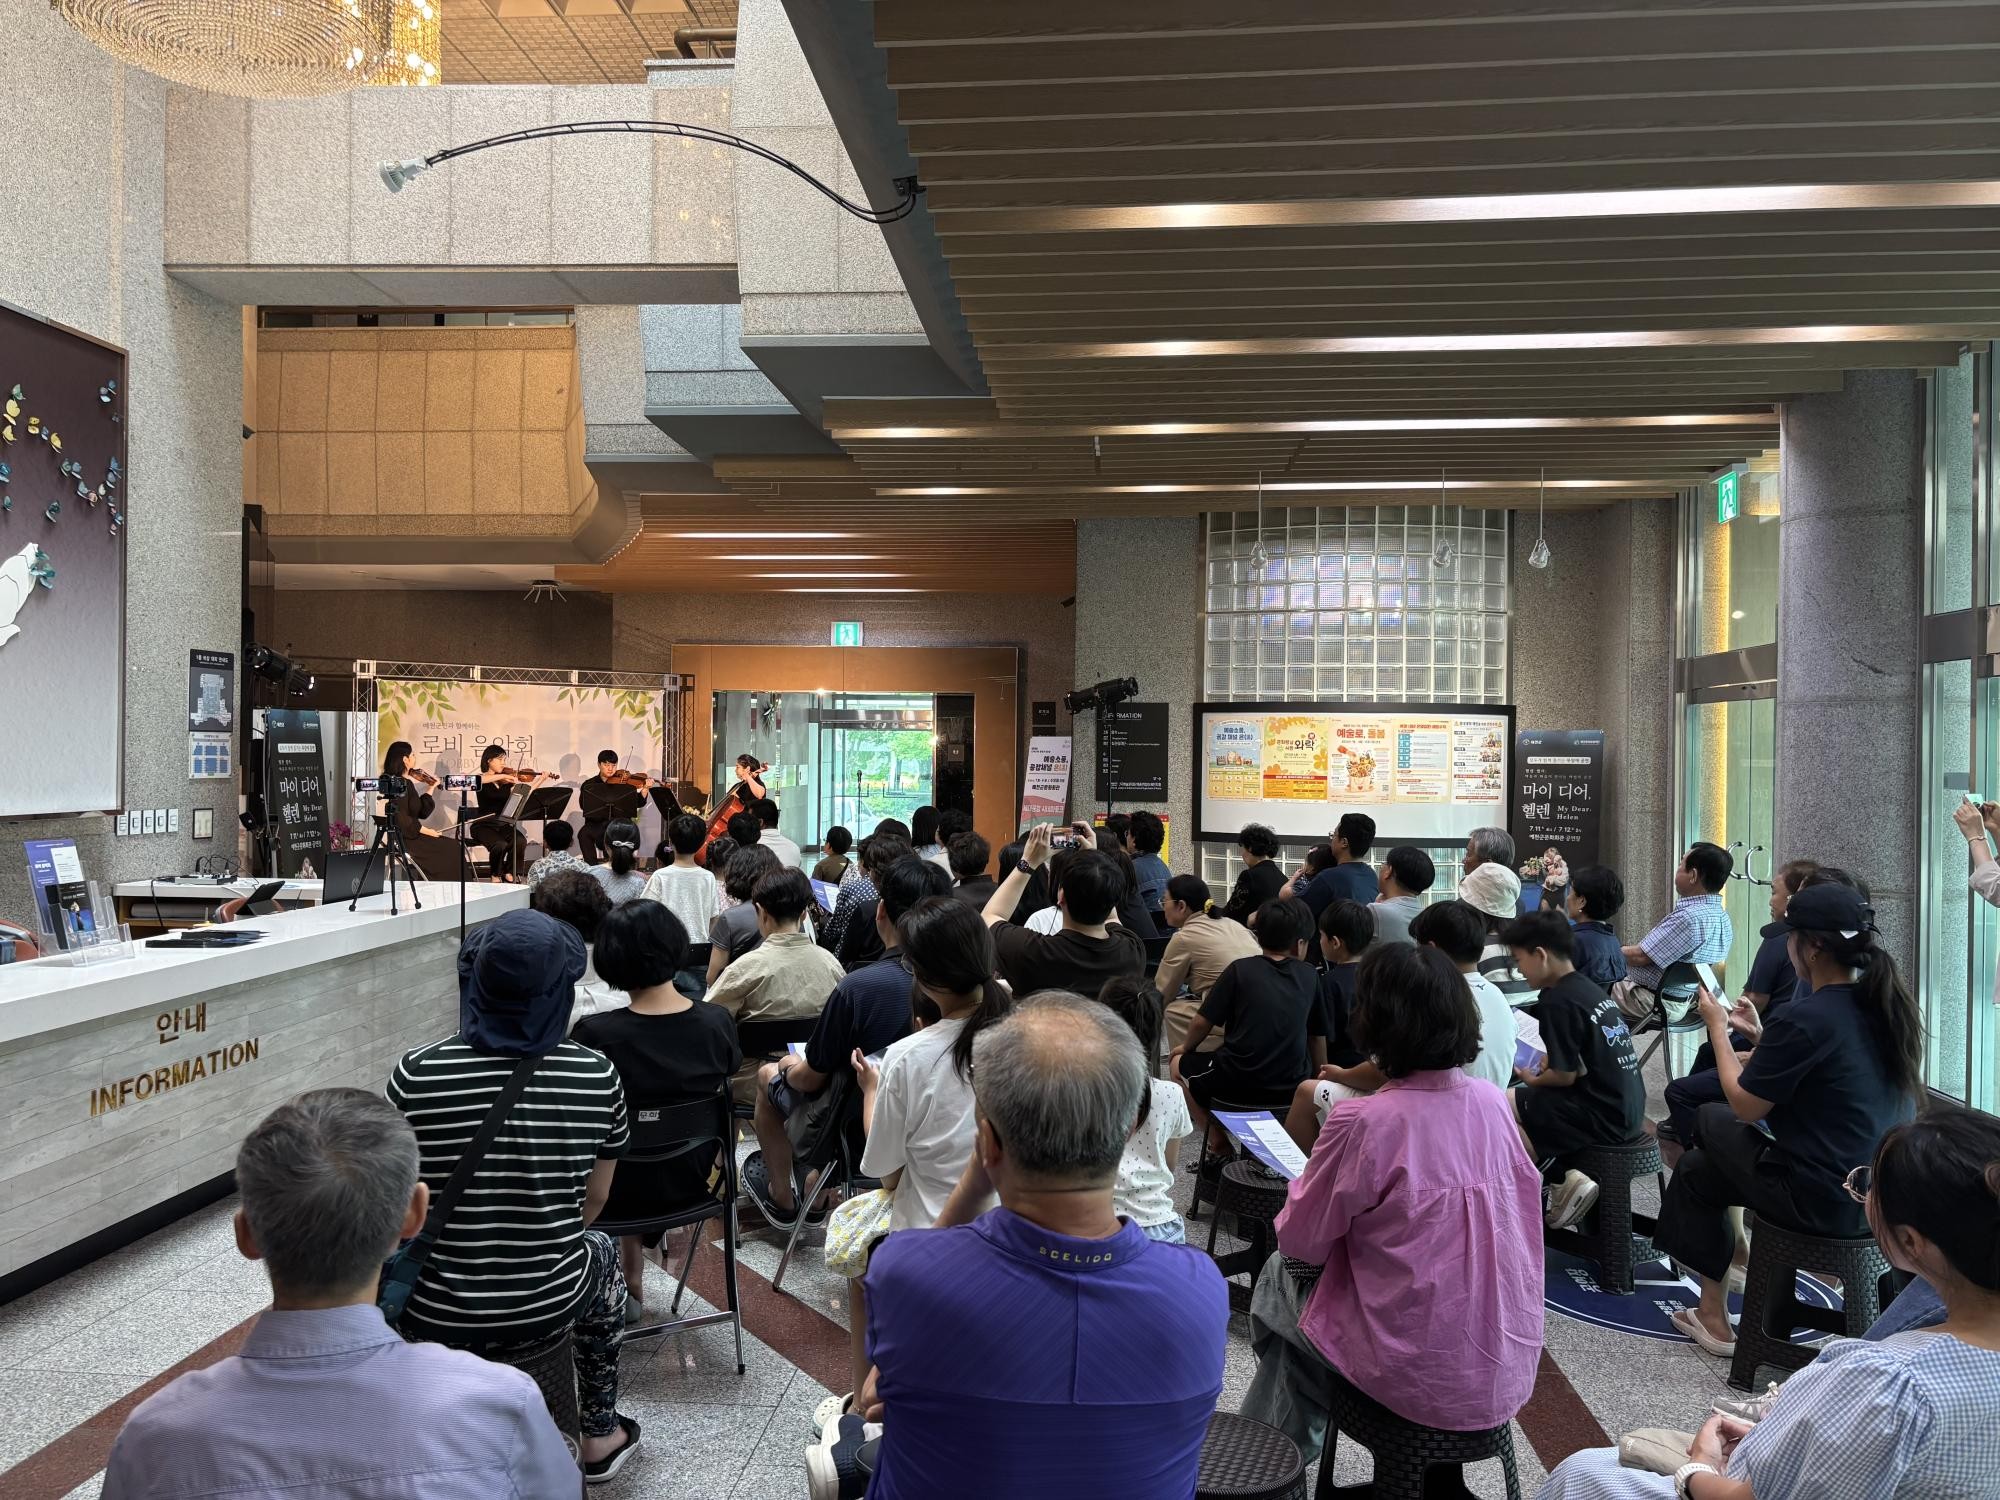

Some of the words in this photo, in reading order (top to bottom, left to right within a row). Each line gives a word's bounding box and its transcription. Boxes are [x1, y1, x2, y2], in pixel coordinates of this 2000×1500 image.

[422, 721, 454, 731] 예천군민과
[419, 733, 463, 758] 로비
[469, 734, 533, 758] 음악회
[280, 776, 299, 799] 마이
[301, 775, 322, 798] 디어,
[1522, 782, 1552, 800] 마이
[1558, 783, 1592, 800] 디어,
[282, 802, 301, 825] 헬렌
[1521, 802, 1551, 820] 헬렌
[1557, 805, 1569, 813] My
[156, 1001, 207, 1045] 안내
[89, 1037, 259, 1117] INFORMATION
